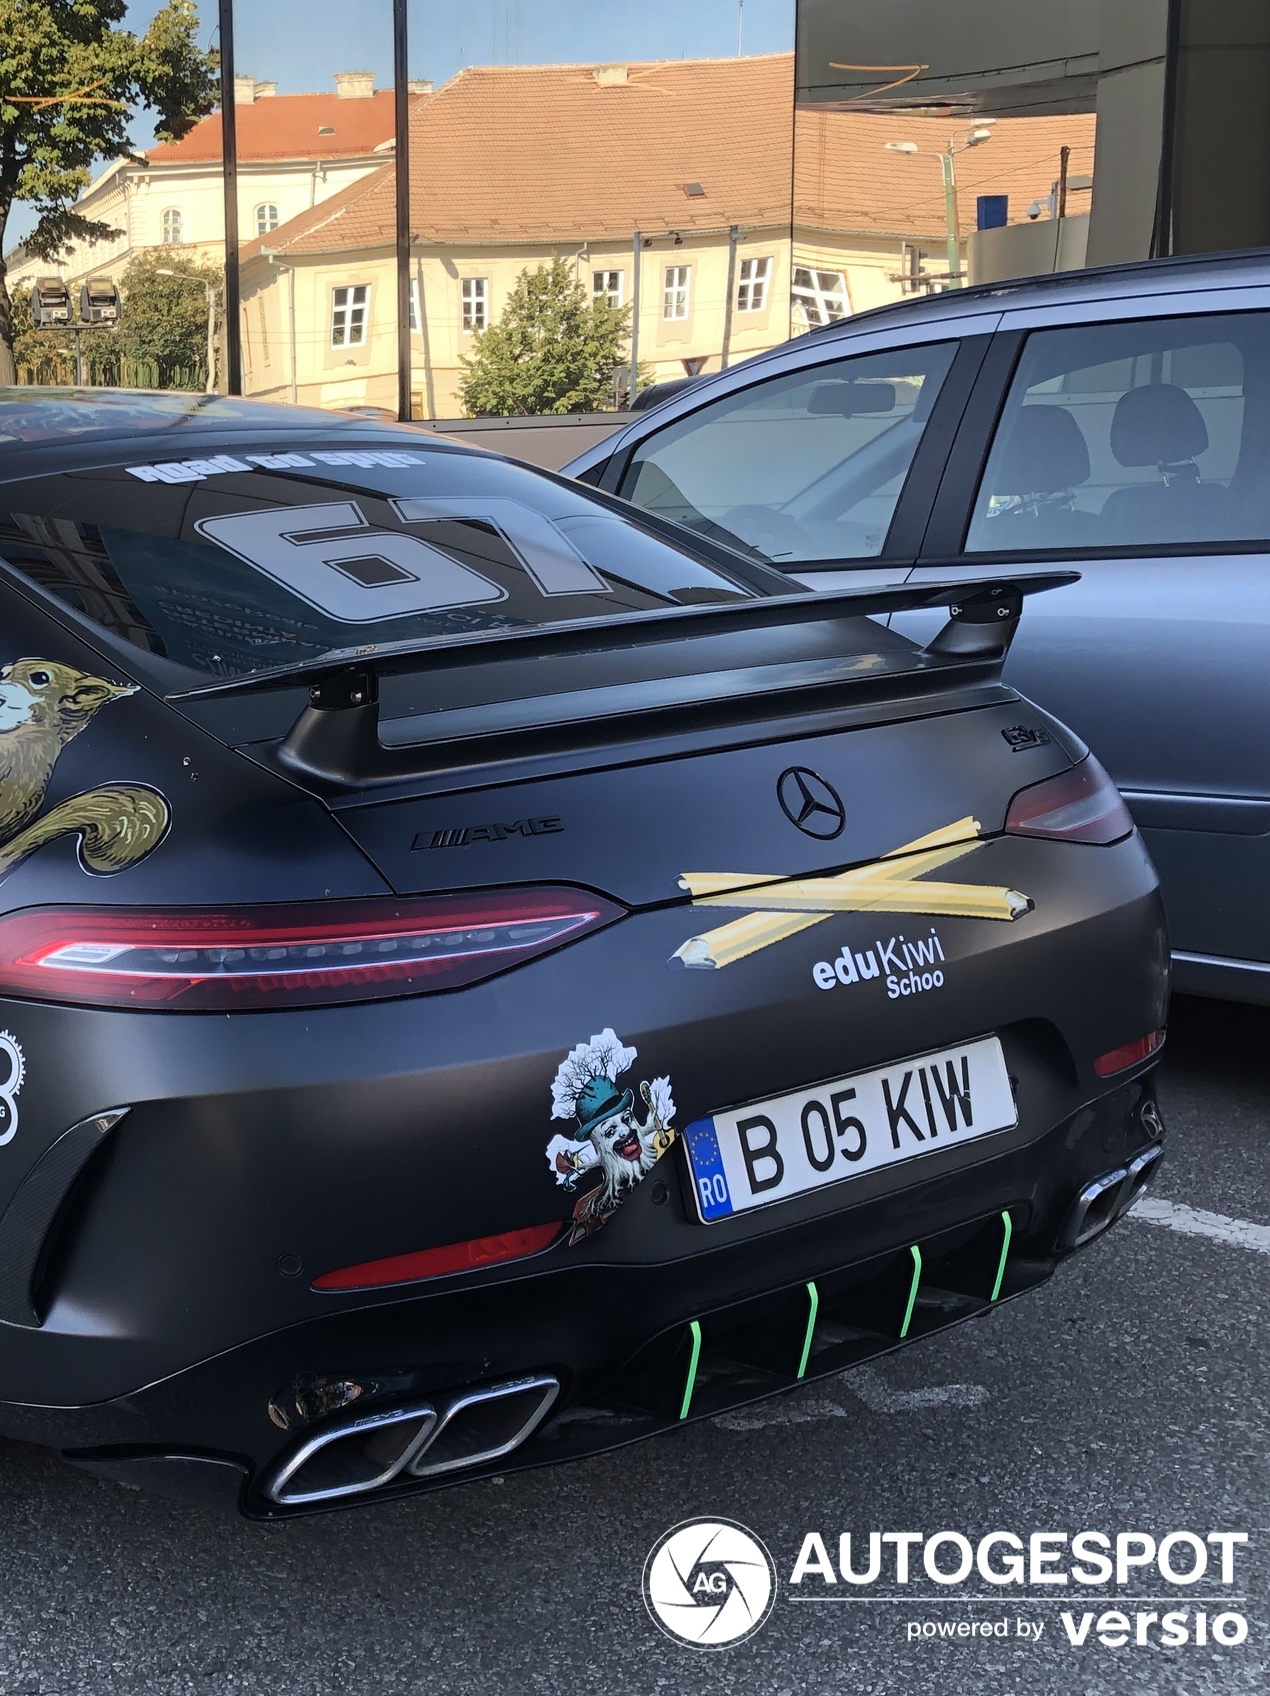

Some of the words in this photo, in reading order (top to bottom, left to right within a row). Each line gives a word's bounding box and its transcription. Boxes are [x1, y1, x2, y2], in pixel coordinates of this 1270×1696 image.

[194, 497, 614, 626] 67
[812, 927, 946, 990] eduKiwi
[736, 1114, 784, 1195] B
[800, 1087, 867, 1172] 05
[881, 1056, 973, 1149] KIW
[698, 1173, 728, 1208] RO
